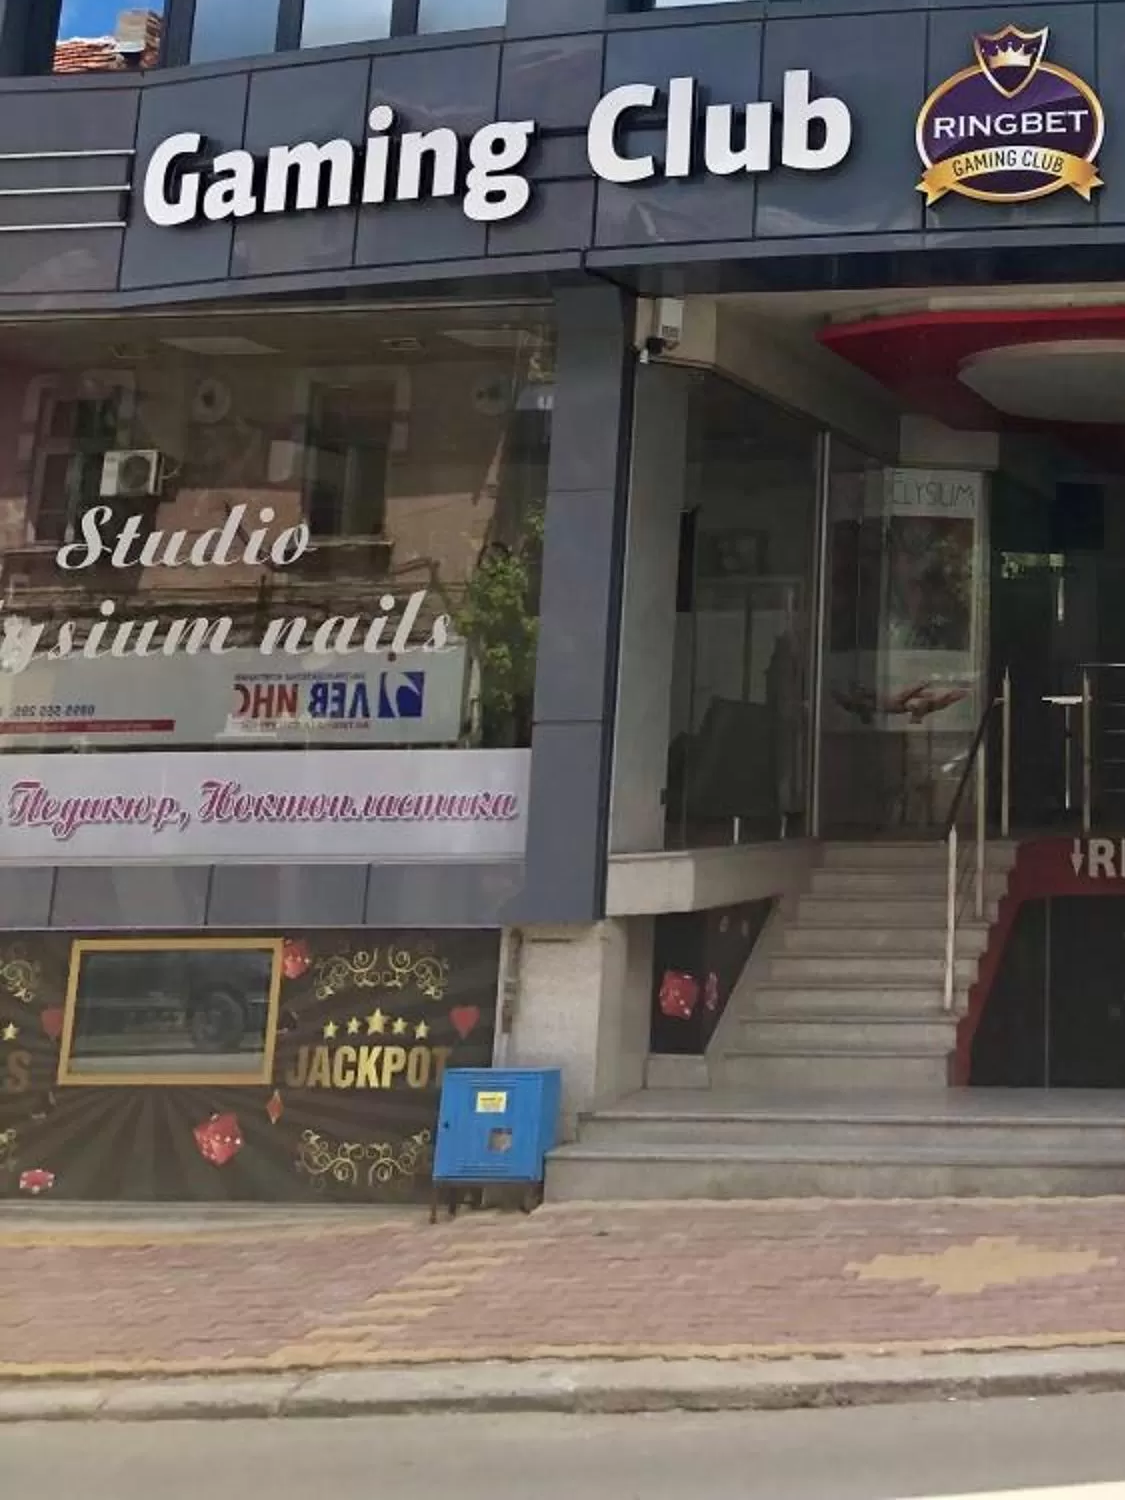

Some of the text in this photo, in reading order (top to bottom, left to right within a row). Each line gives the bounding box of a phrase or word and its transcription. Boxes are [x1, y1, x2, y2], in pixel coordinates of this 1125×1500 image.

[142, 68, 852, 227] Gaming Club
[933, 109, 1089, 139] RINGBET
[952, 148, 1065, 178] GAMING CLUB
[56, 503, 320, 570] Studio
[0, 588, 460, 675] ysium nails
[286, 1044, 452, 1089] JACKPOT
